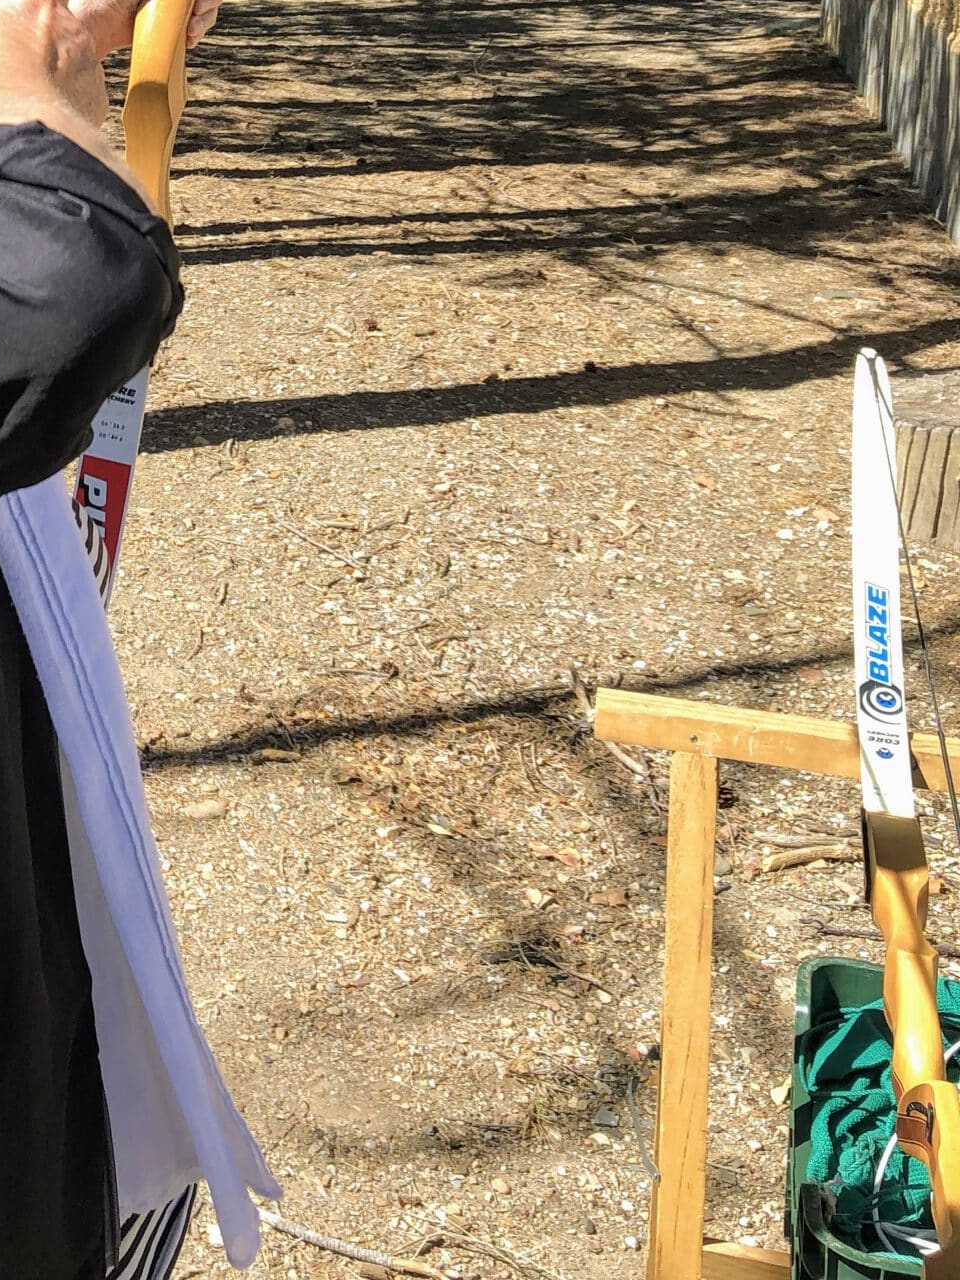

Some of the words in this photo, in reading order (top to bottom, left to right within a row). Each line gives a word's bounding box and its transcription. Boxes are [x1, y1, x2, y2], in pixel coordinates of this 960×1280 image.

[118, 386, 137, 398] RE
[110, 394, 136, 406] CHERY
[866, 584, 890, 684] BLAZE
[867, 735, 900, 746] CORE
